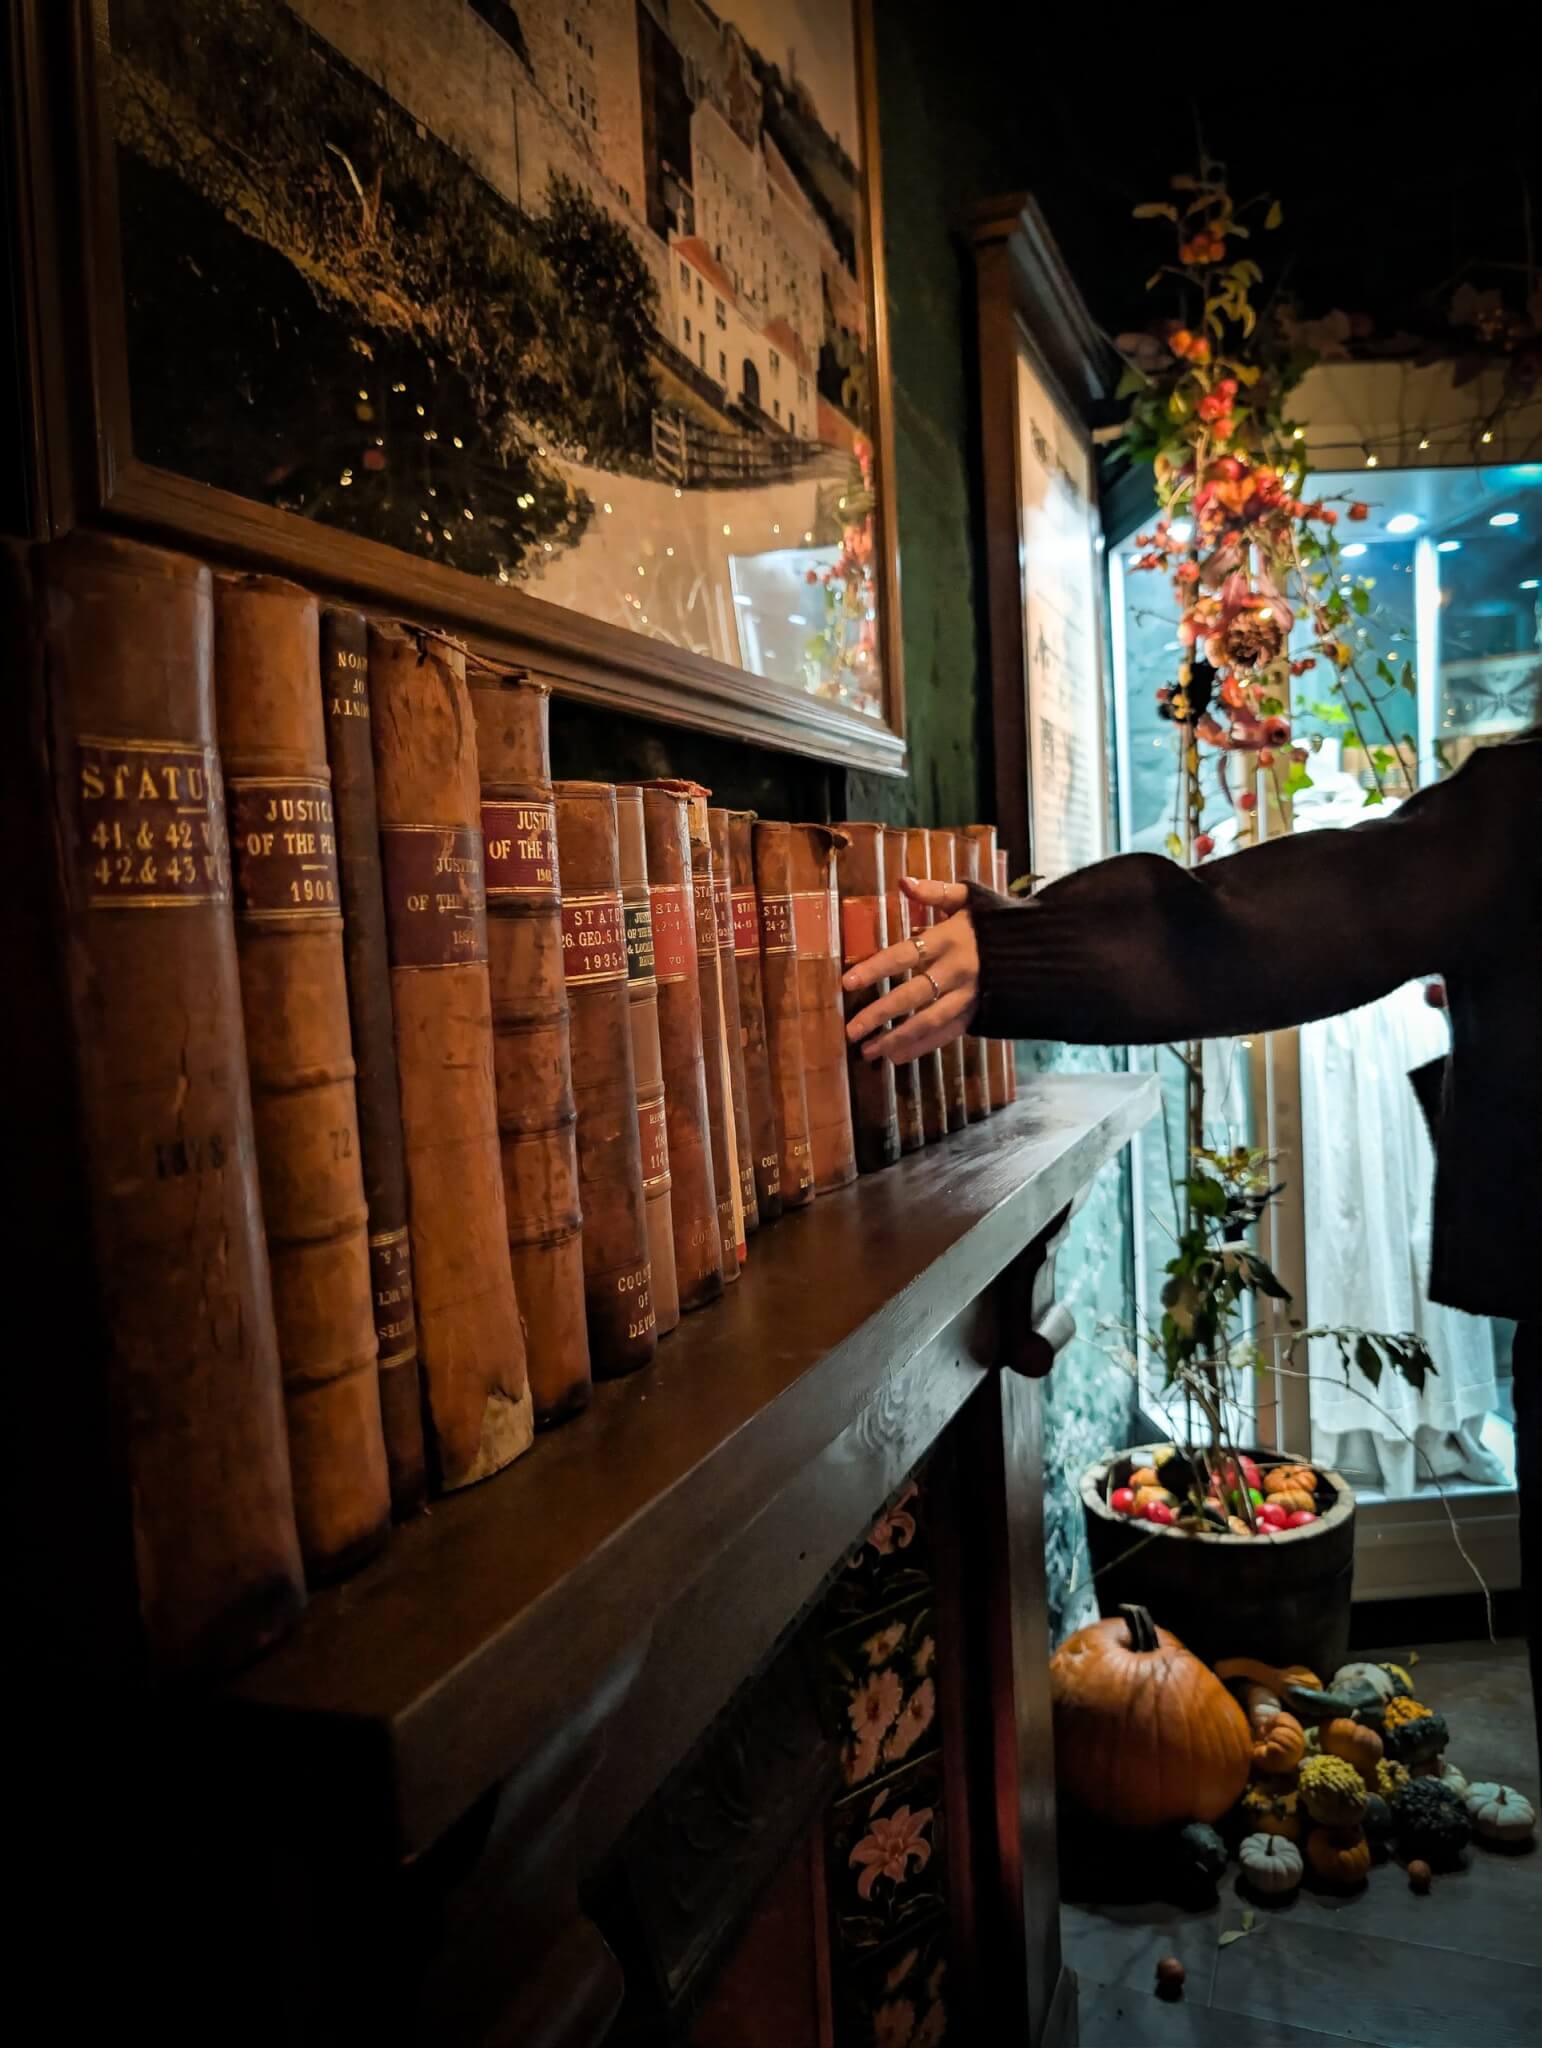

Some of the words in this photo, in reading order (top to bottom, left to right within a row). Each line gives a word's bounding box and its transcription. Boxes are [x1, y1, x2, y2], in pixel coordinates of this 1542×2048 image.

[136, 820, 154, 849] &
[165, 820, 193, 849] 42
[247, 832, 275, 856] OF
[283, 833, 317, 855] THE
[489, 839, 511, 860] OF
[517, 840, 544, 859] THE
[140, 855, 158, 884] &
[407, 894, 430, 912] OF
